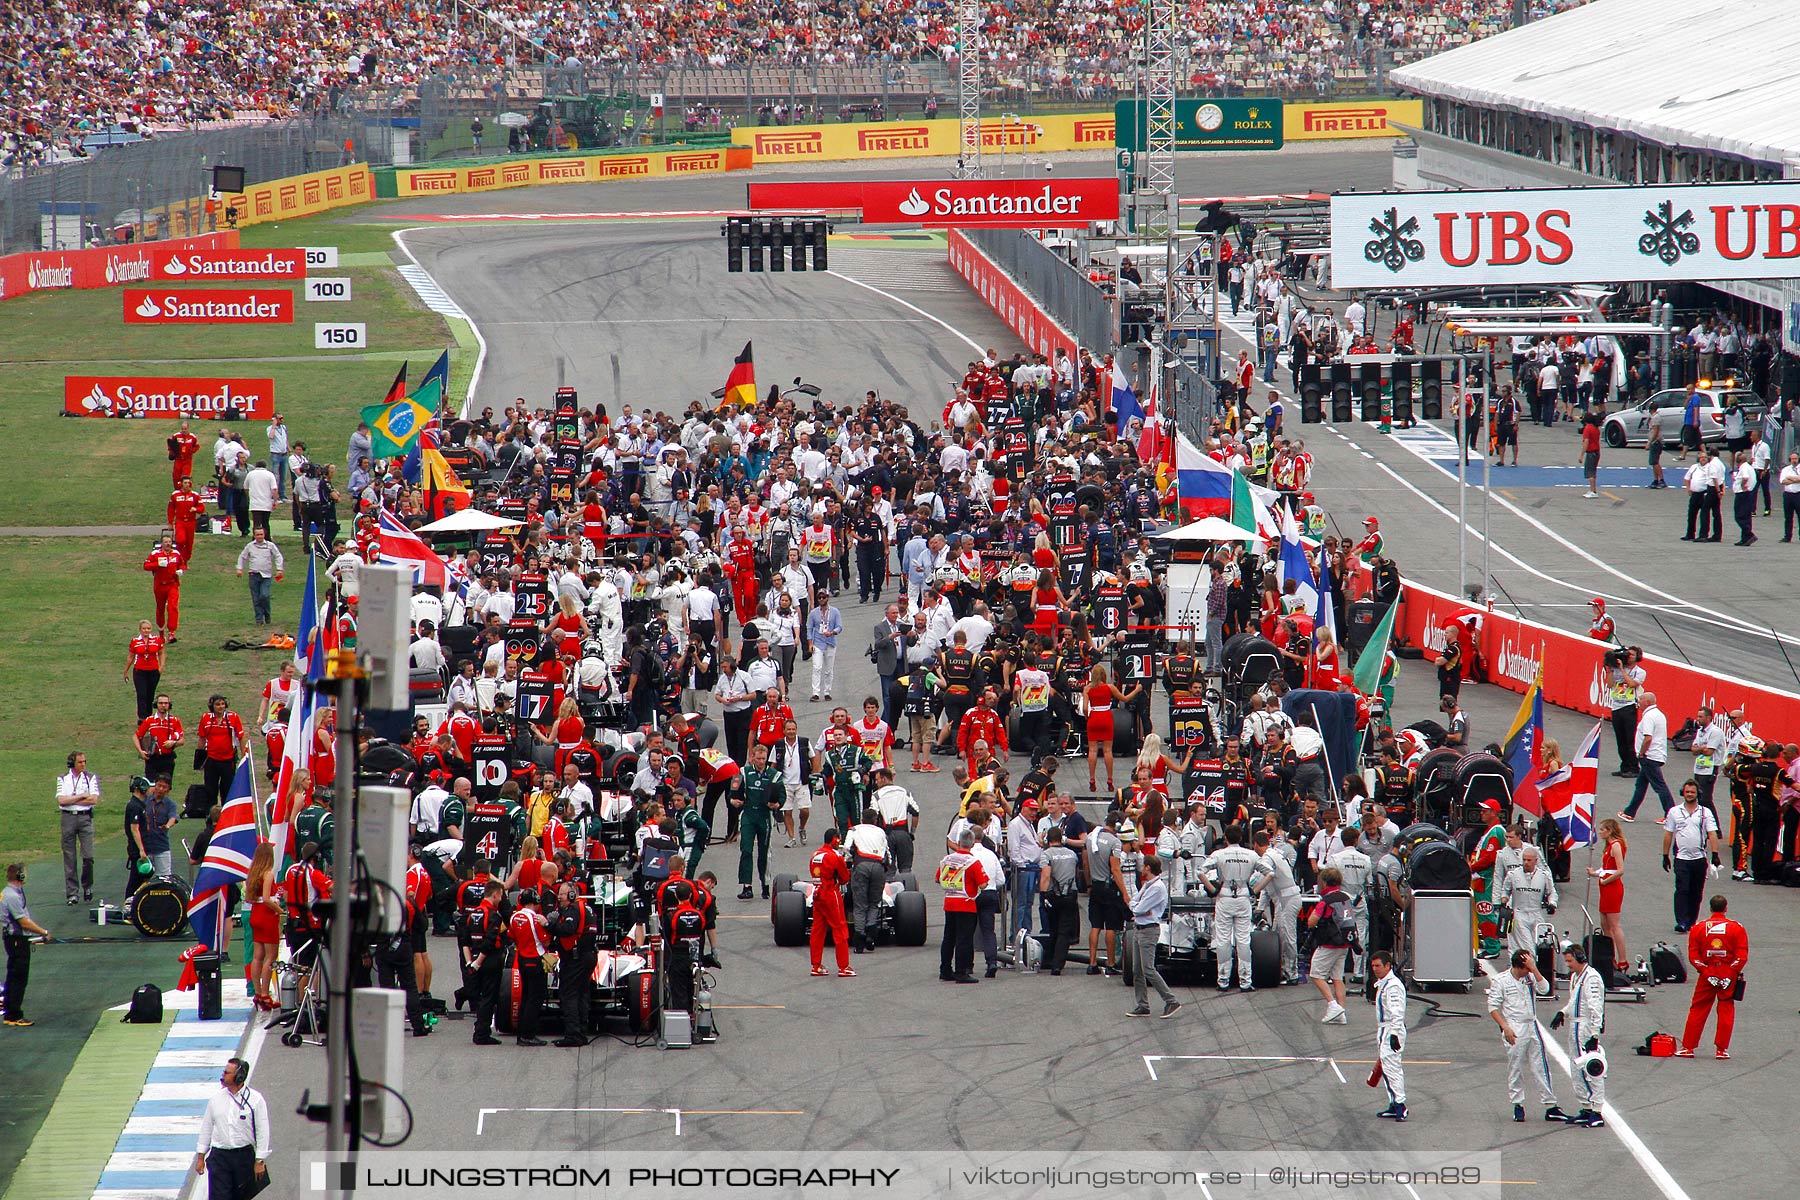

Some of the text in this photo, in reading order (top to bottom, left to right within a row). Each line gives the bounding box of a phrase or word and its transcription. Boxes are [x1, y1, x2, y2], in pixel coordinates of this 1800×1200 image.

[653, 95, 660, 105] 3
[1074, 119, 1116, 142] PIRE
[1234, 121, 1272, 129] ROLEX
[1304, 109, 1387, 131] PIRELLI
[755, 132, 822, 155] PIRELLI
[858, 127, 929, 151] PIRELLI
[503, 164, 530, 183] PIRELLI
[539, 161, 585, 179] PIRELLI
[600, 158, 648, 176] PIRELLI
[666, 153, 719, 172] PIRELLI
[326, 176, 343, 200] PIRELLI
[349, 171, 365, 196] PIRELLI
[410, 172, 457, 191] PIRELLI
[468, 169, 495, 188] PIRELLI
[255, 190, 272, 216] PIRELLI
[280, 185, 296, 210] PIRELLI
[304, 179, 320, 205] PIRELLI
[934, 185, 1083, 216] Santander
[1433, 209, 1573, 268] UBS
[113, 249, 150, 283] Santander
[189, 254, 295, 275] Santander
[306, 252, 327, 264] 50
[35, 256, 72, 288] Santander
[312, 283, 344, 296] 100
[164, 296, 280, 318] Santander
[322, 329, 358, 343] 150
[116, 384, 259, 413] Santander
[551, 483, 571, 501] 14
[1051, 492, 1076, 510] 26
[1056, 525, 1075, 544] 11
[483, 553, 510, 573] 22
[1068, 563, 1084, 585] 7
[517, 593, 546, 614] 25
[1102, 607, 1119, 630] 8
[506, 639, 537, 661] 99
[1126, 655, 1151, 678] 21
[520, 694, 550, 719] 17
[1175, 721, 1205, 746] 13
[477, 759, 507, 786] 10
[1188, 785, 1226, 813] 44
[476, 831, 498, 859] 4
